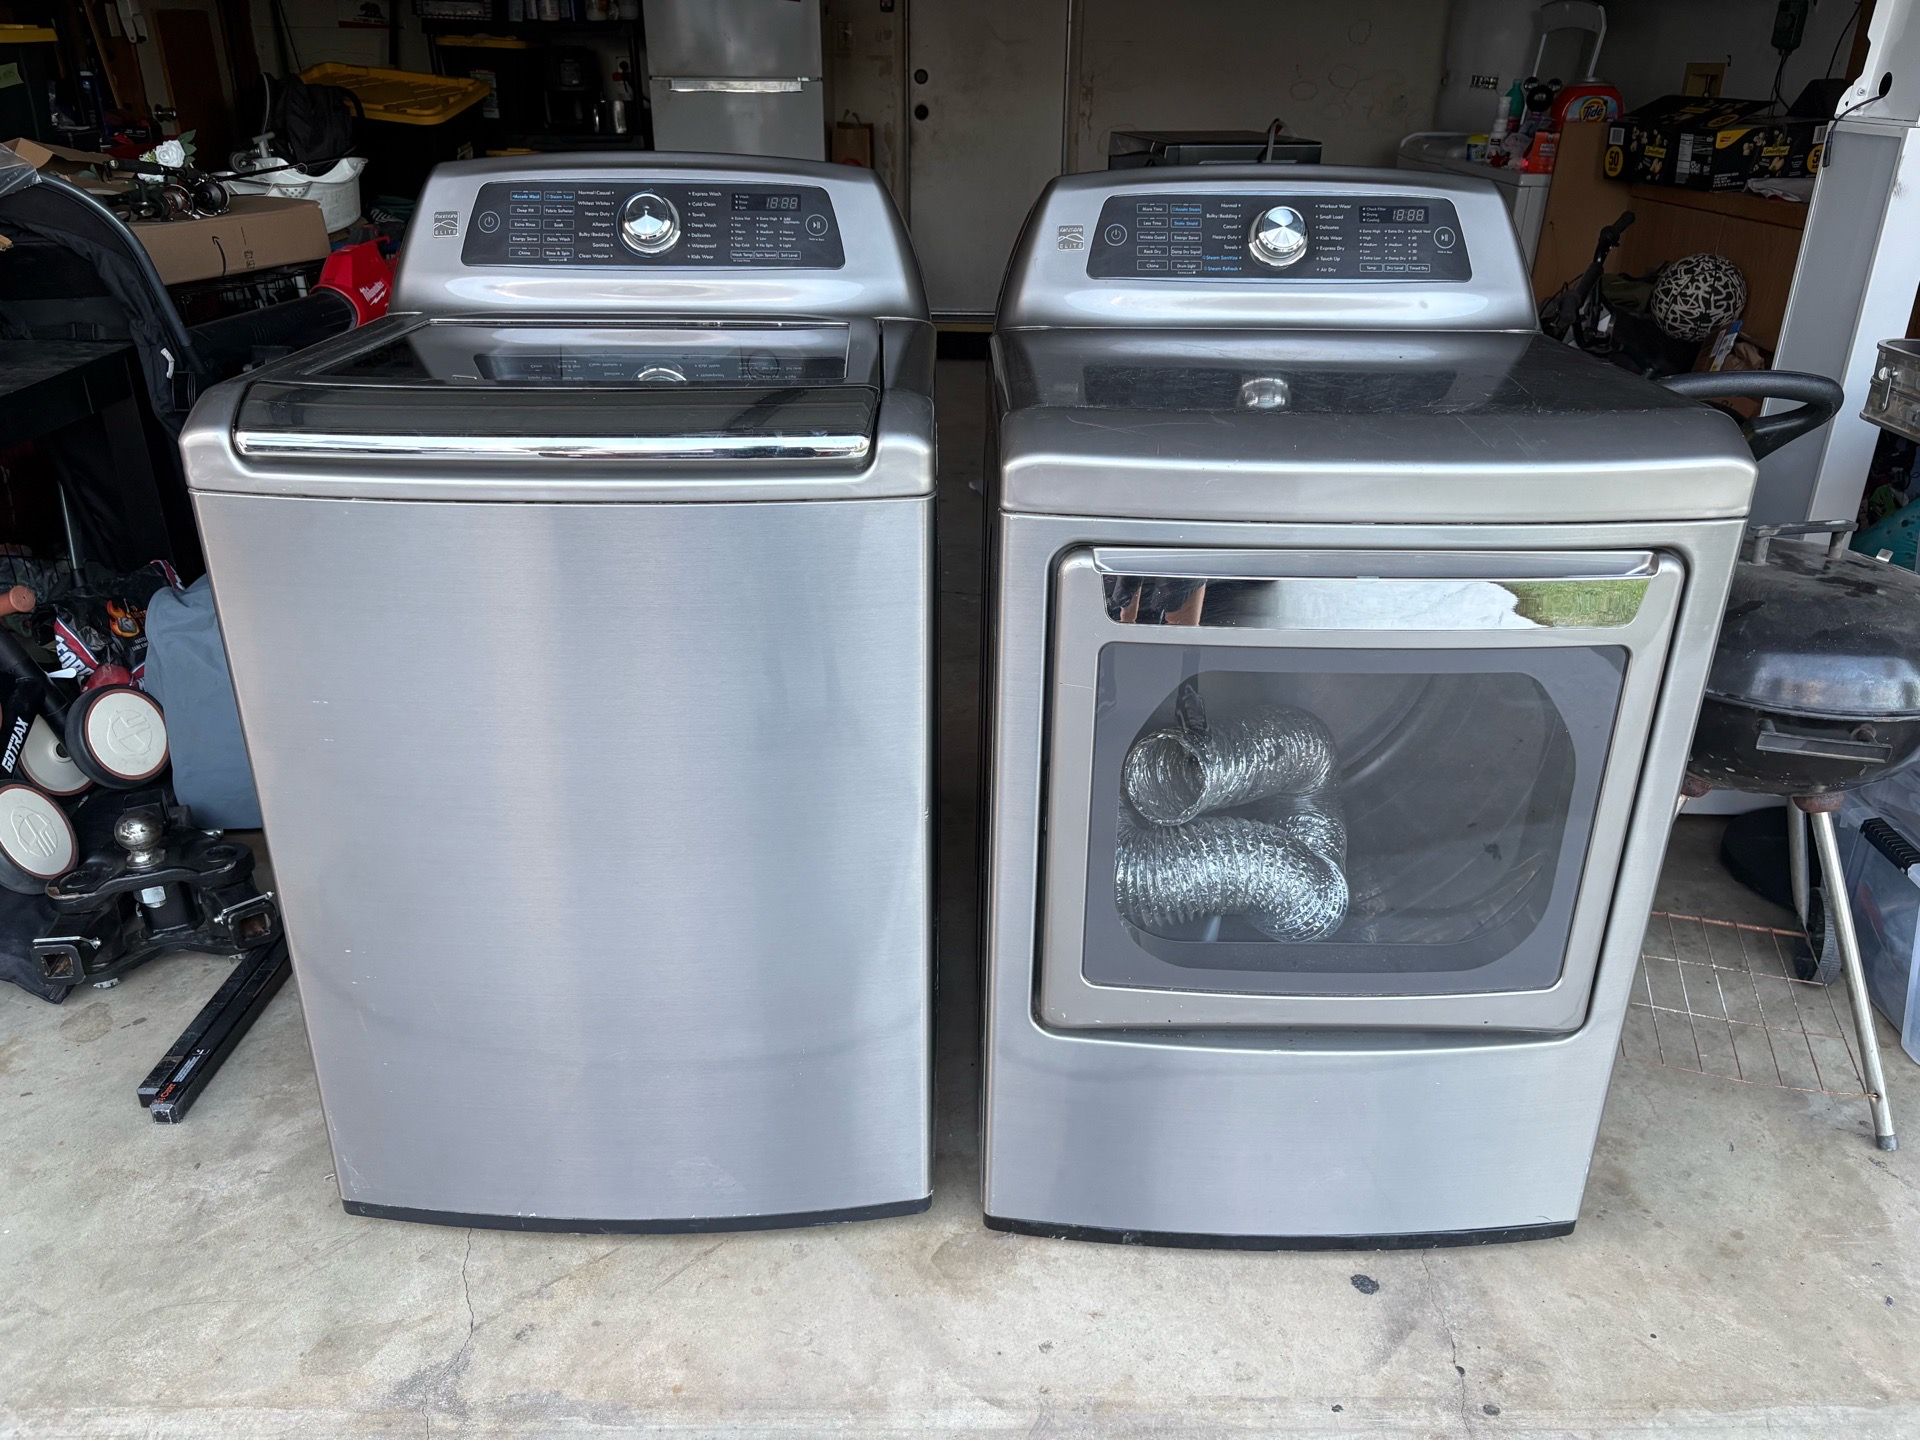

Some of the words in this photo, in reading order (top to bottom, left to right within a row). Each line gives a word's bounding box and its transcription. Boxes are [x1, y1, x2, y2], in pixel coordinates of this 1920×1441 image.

[1583, 105, 1603, 120] Tide
[1608, 150, 1619, 166] 50
[1, 716, 29, 773] GOTRAX
